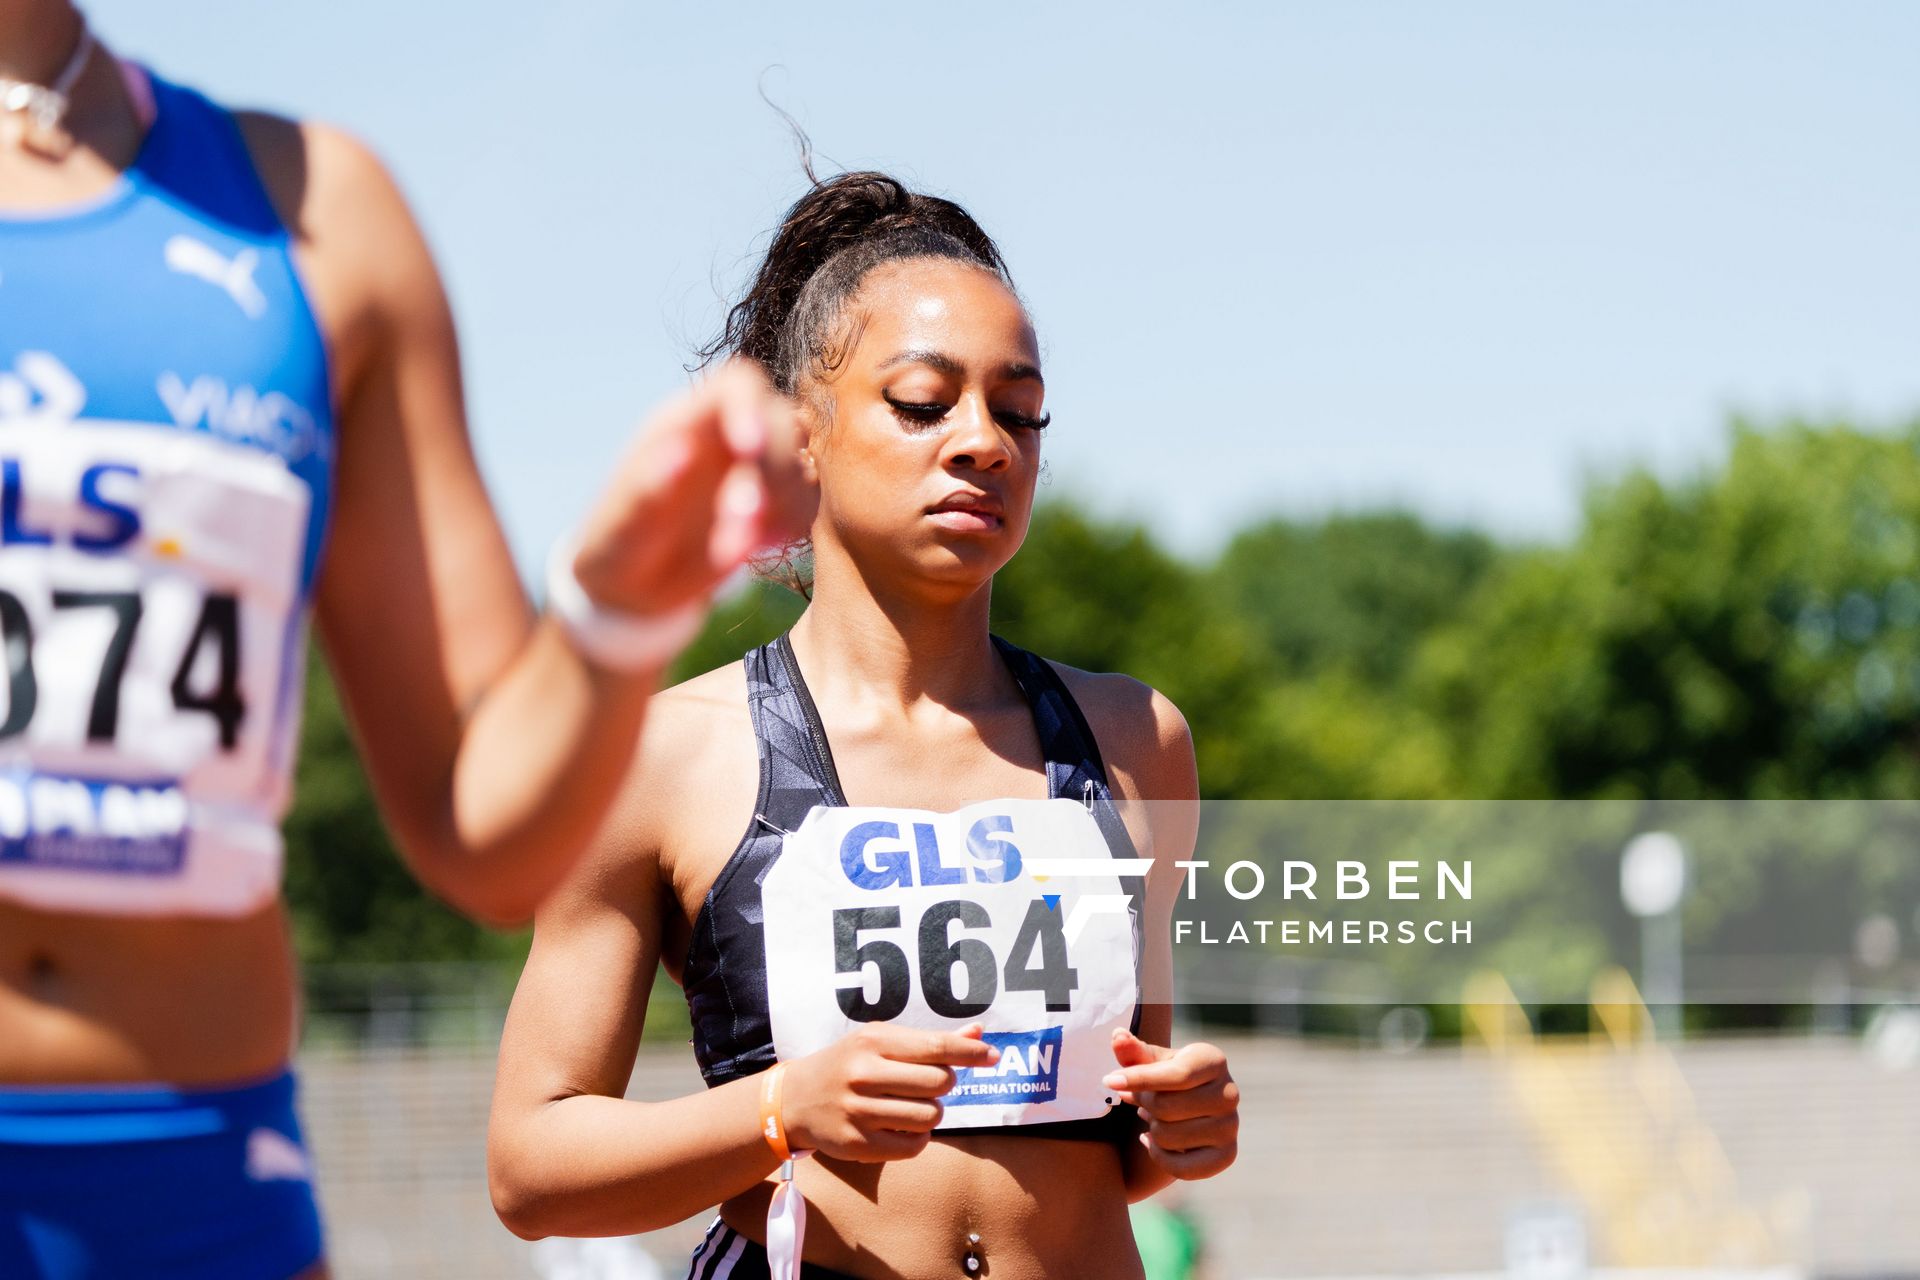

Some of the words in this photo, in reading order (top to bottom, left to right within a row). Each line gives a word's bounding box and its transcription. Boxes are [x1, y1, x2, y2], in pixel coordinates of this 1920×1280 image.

[839, 815, 1023, 891] GLS
[832, 899, 1079, 1023] 564
[948, 1081, 1051, 1096] NTERNATIONAL
